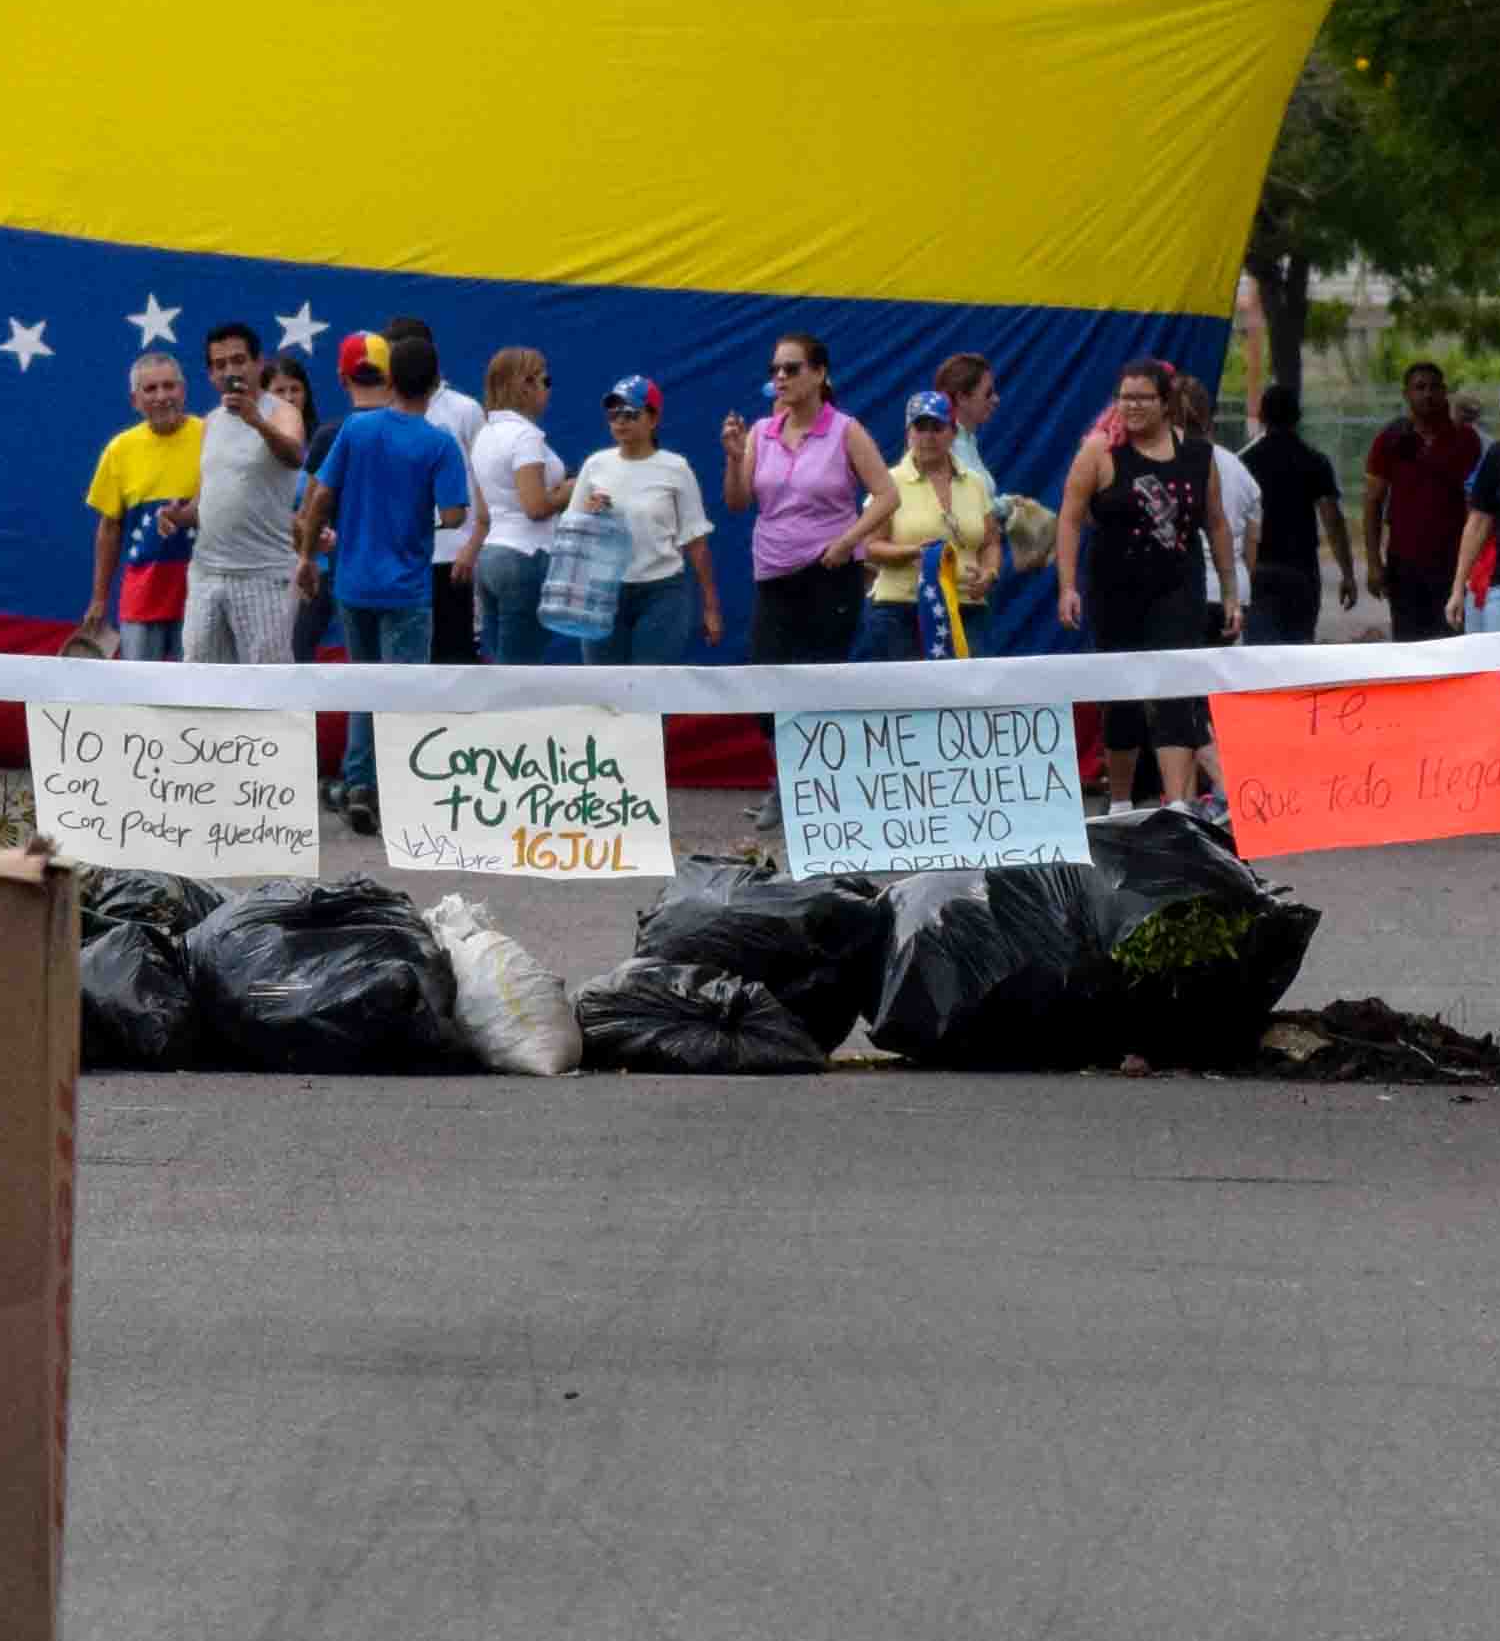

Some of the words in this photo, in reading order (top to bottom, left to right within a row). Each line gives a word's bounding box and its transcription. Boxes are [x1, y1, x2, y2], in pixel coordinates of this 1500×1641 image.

[124, 734, 164, 779] no
[792, 719, 846, 771] YO
[862, 714, 921, 767] ME
[937, 706, 1061, 761] QUEDO
[232, 780, 296, 811] sino
[793, 772, 841, 817] EN
[855, 761, 1074, 814] VENEZUELA
[1239, 778, 1304, 824] Que
[203, 815, 318, 859] quedarme
[803, 820, 873, 856] POR
[882, 815, 950, 850] QUE
[967, 809, 1013, 842] YO
